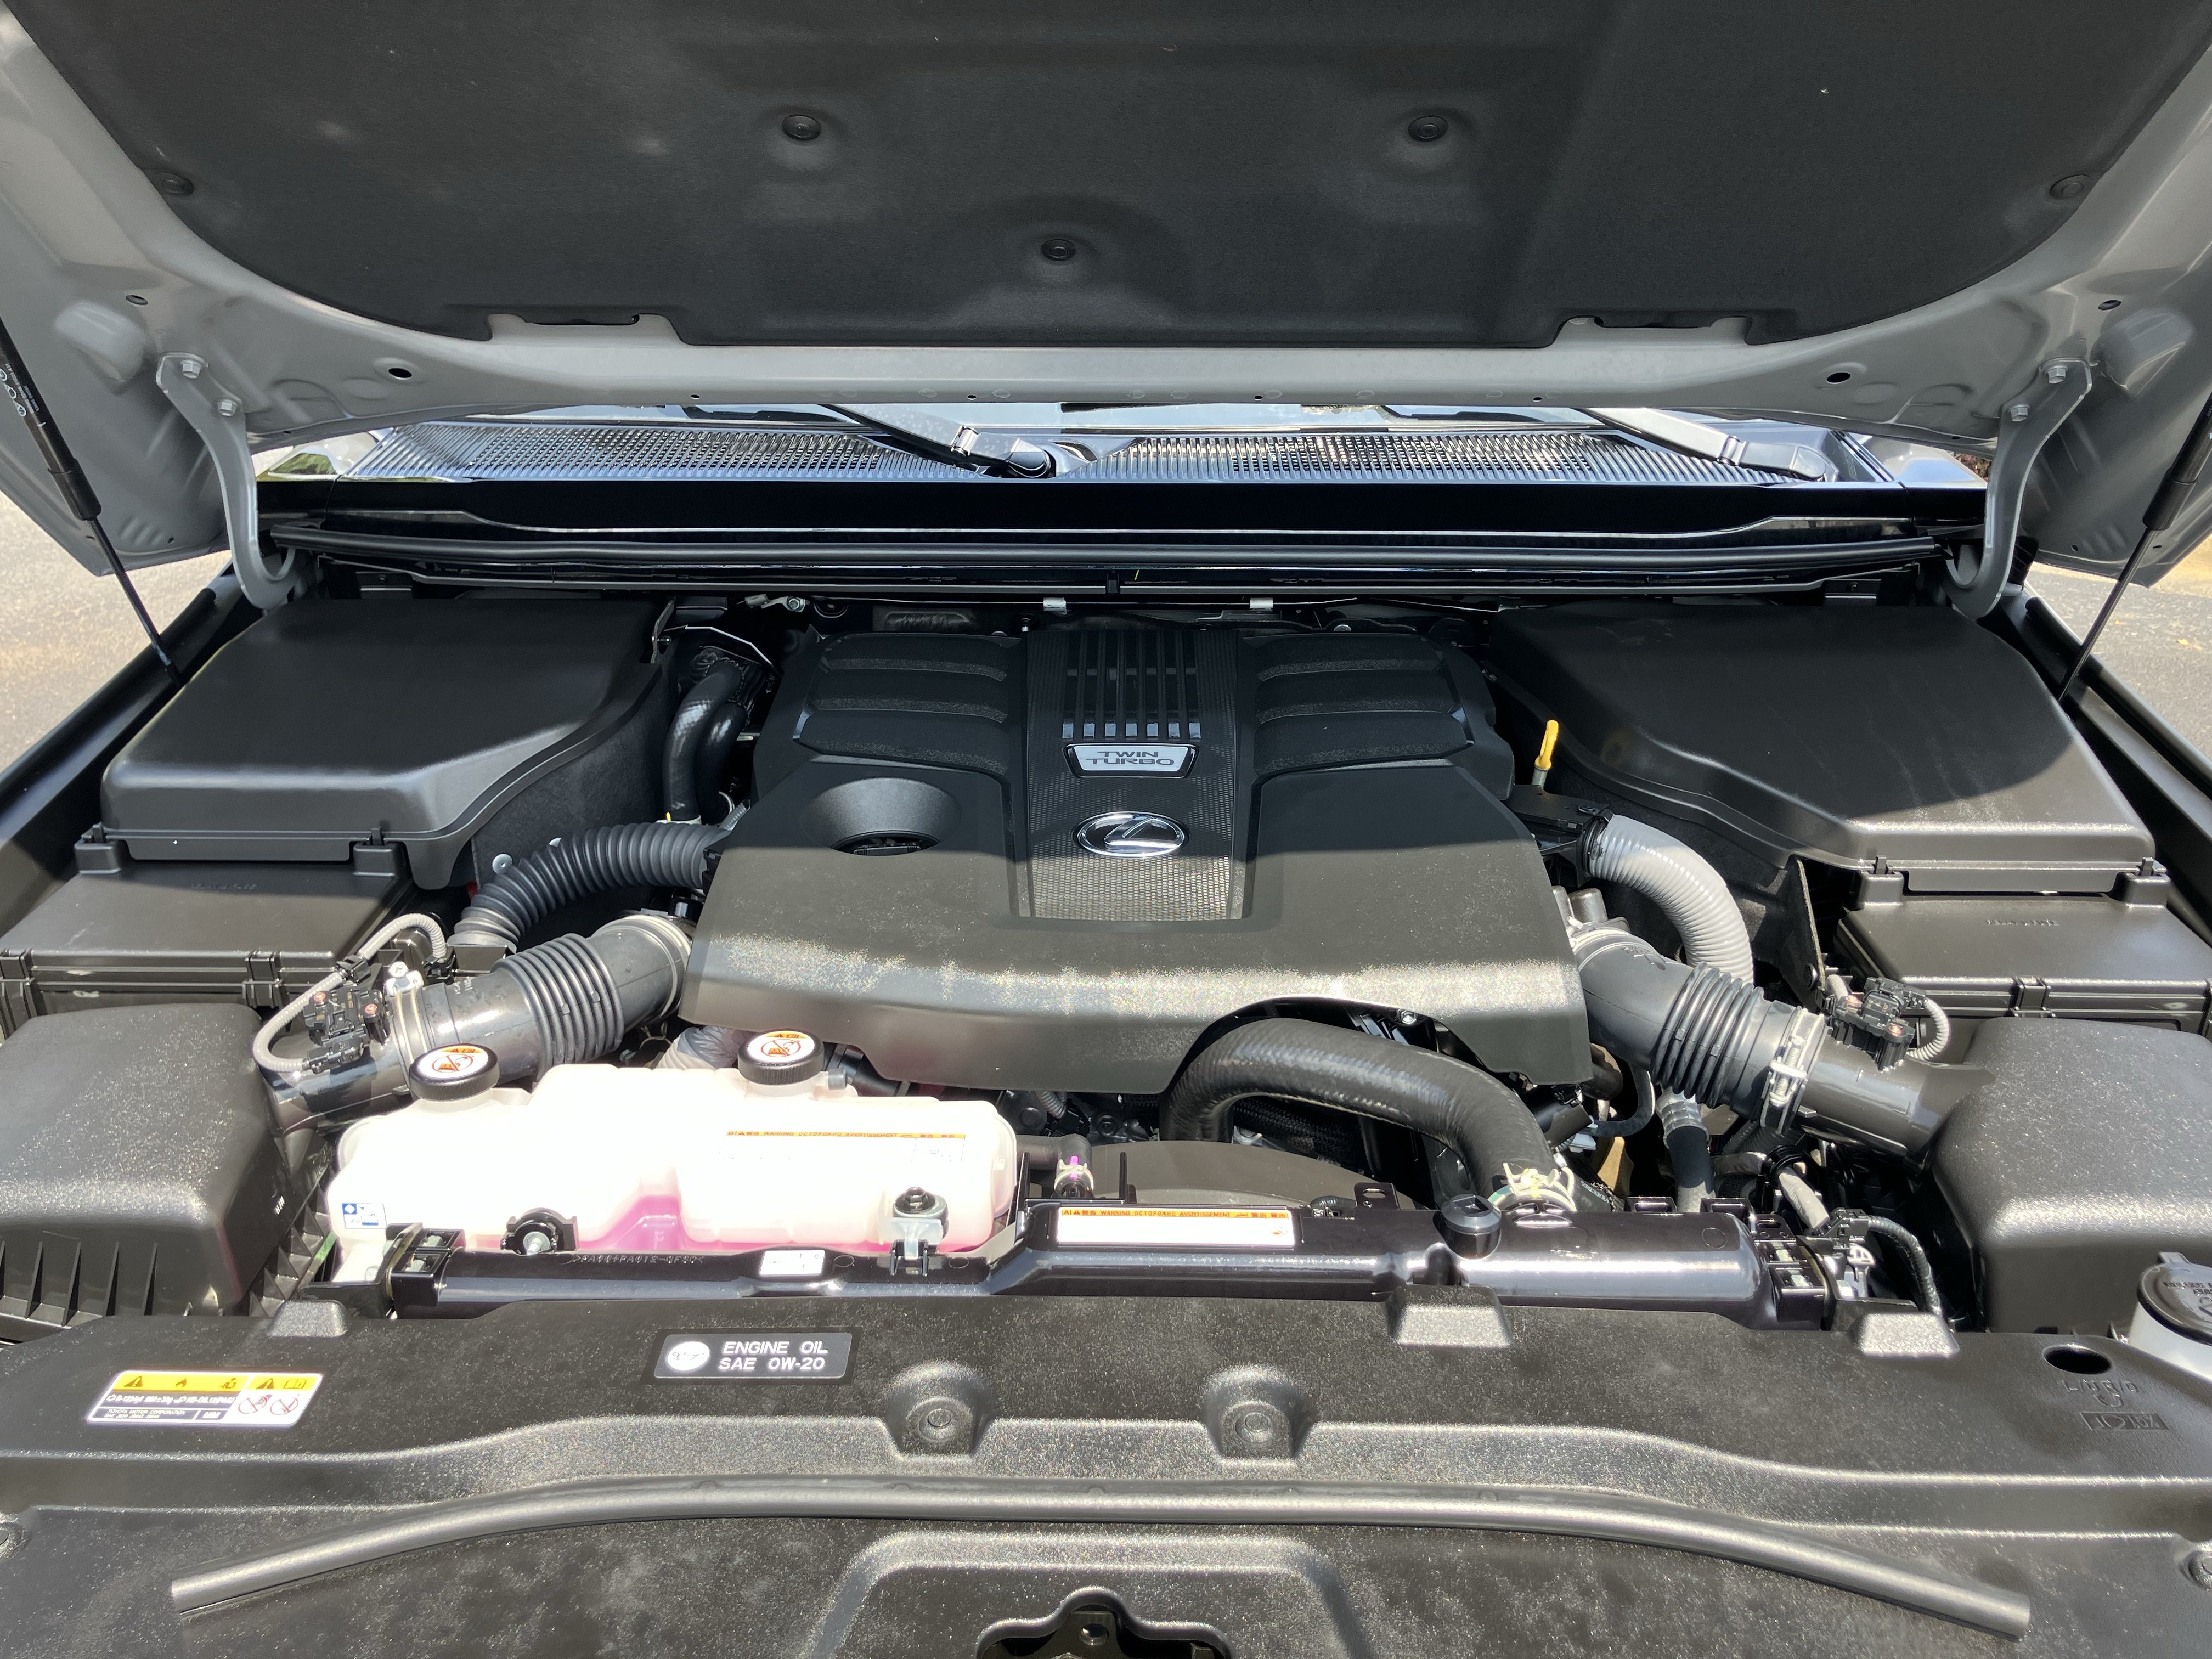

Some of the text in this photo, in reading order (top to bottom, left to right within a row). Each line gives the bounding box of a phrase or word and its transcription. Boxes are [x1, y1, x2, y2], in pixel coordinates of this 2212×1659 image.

[722, 1341, 828, 1355] ENGINE OIL
[718, 1357, 825, 1370] SAE 0W-20
